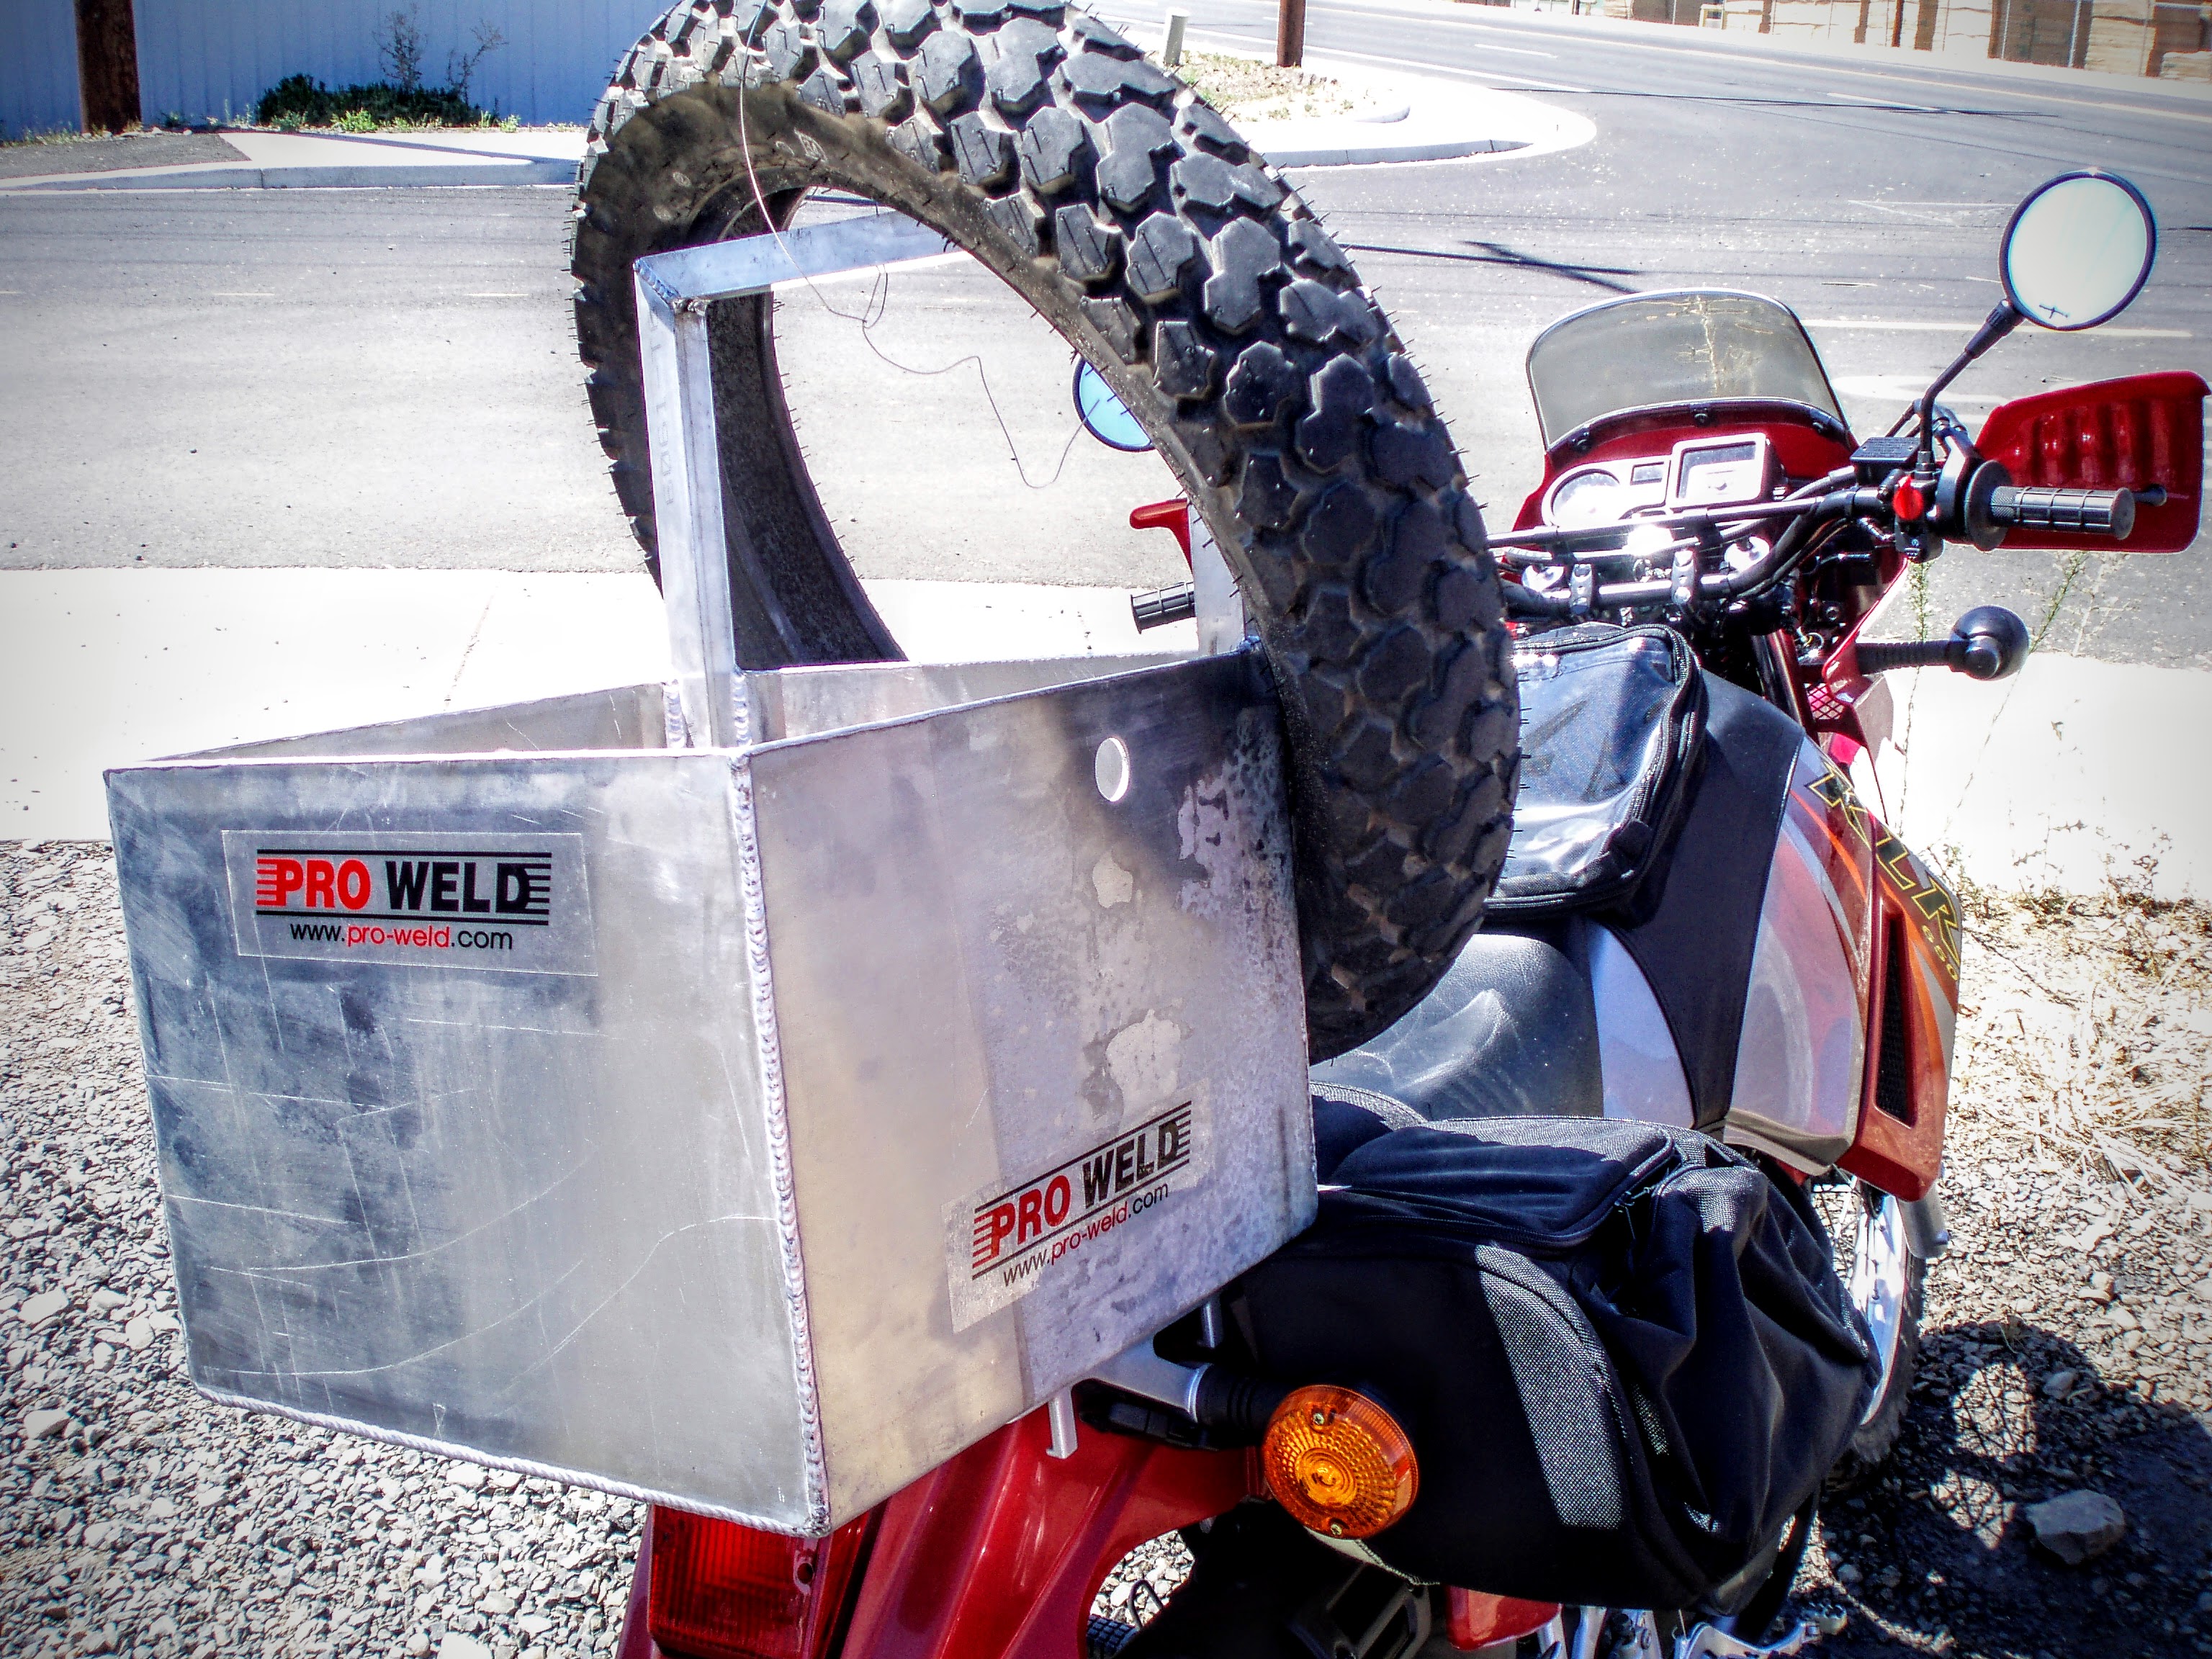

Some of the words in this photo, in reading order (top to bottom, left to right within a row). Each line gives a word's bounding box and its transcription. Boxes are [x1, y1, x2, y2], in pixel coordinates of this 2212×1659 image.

[256, 858, 371, 910] PRO
[385, 860, 552, 915] WELD
[1805, 756, 1960, 967] KLR
[289, 923, 513, 950] www.pro-weld.com
[972, 1174, 1071, 1269] PRO
[1082, 1109, 1192, 1210] WELD
[1003, 1182, 1169, 1287] www.pro-weld.com
